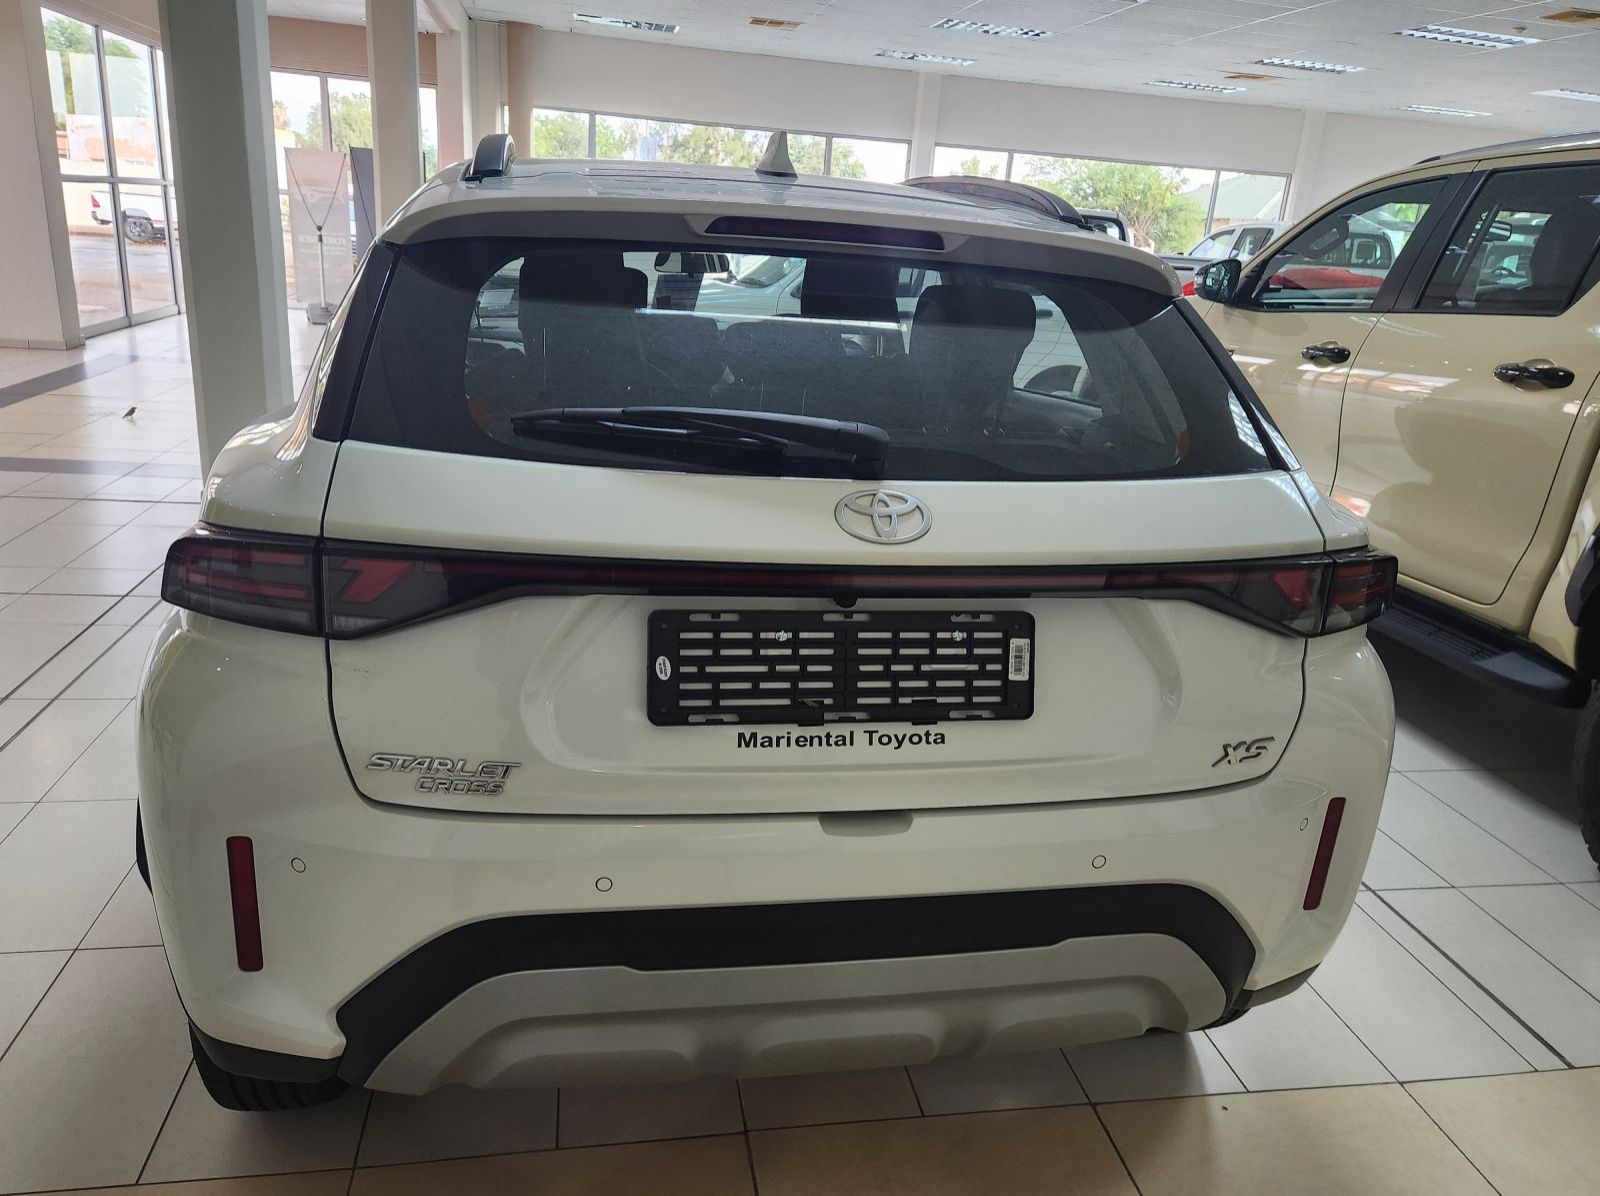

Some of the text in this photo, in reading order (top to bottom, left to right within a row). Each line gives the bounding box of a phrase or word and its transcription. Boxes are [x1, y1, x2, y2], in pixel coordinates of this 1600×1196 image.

[737, 729, 946, 750] Mariental Toyota
[1211, 736, 1275, 767] XS
[366, 752, 523, 779] STARLET
[416, 776, 506, 795] CROSS
